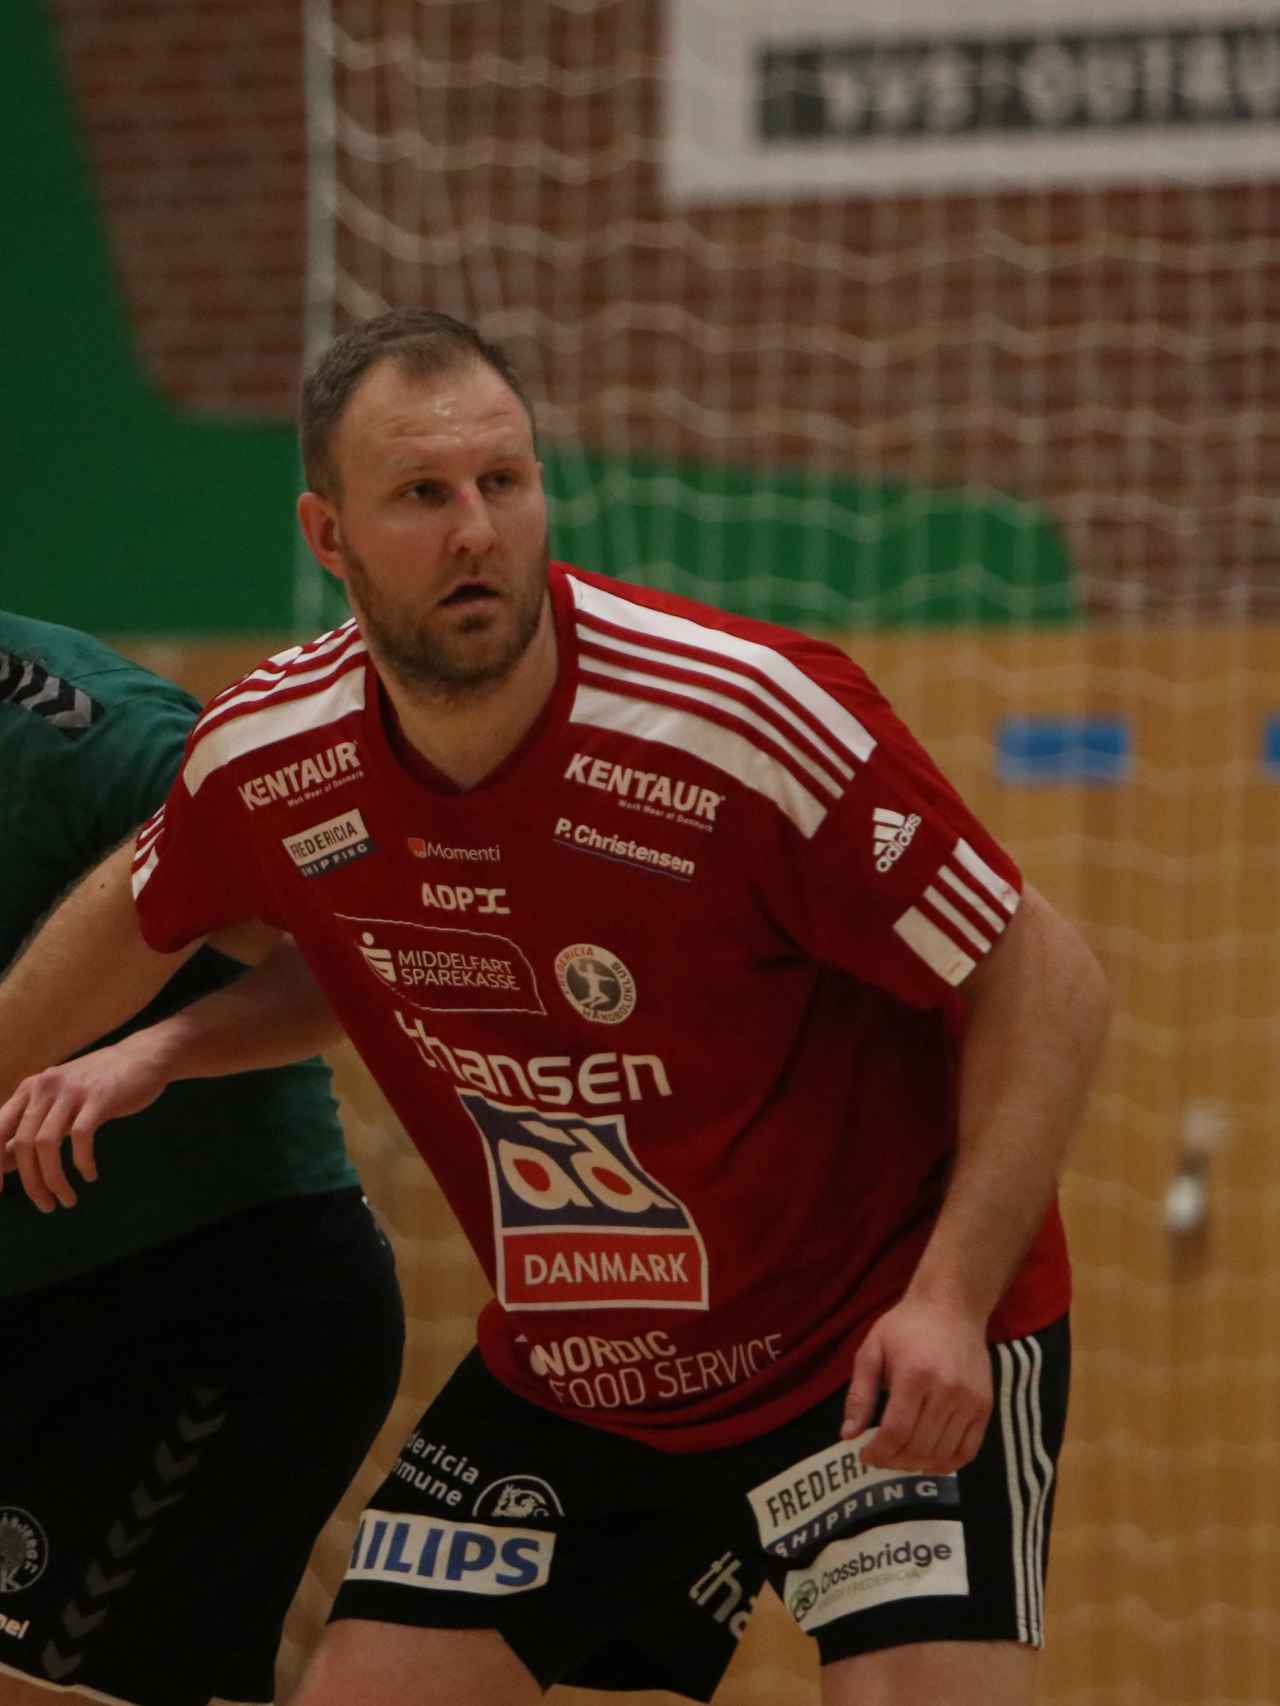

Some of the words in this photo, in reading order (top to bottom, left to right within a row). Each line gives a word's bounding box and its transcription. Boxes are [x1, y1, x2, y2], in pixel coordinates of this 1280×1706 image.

[238, 741, 361, 811] KENTAUR
[563, 751, 721, 822] KENTAUR
[427, 841, 501, 862] Momenti
[875, 812, 922, 874] adidas
[398, 950, 513, 975] MIDDELFART
[400, 968, 520, 991] SPAREKASSE
[523, 1251, 689, 1286] DANMARK
[531, 1330, 677, 1377] NORDIC
[549, 1366, 647, 1409] FOOD
[393, 1457, 464, 1507] mune
[774, 1480, 939, 1559] SHIPPING
